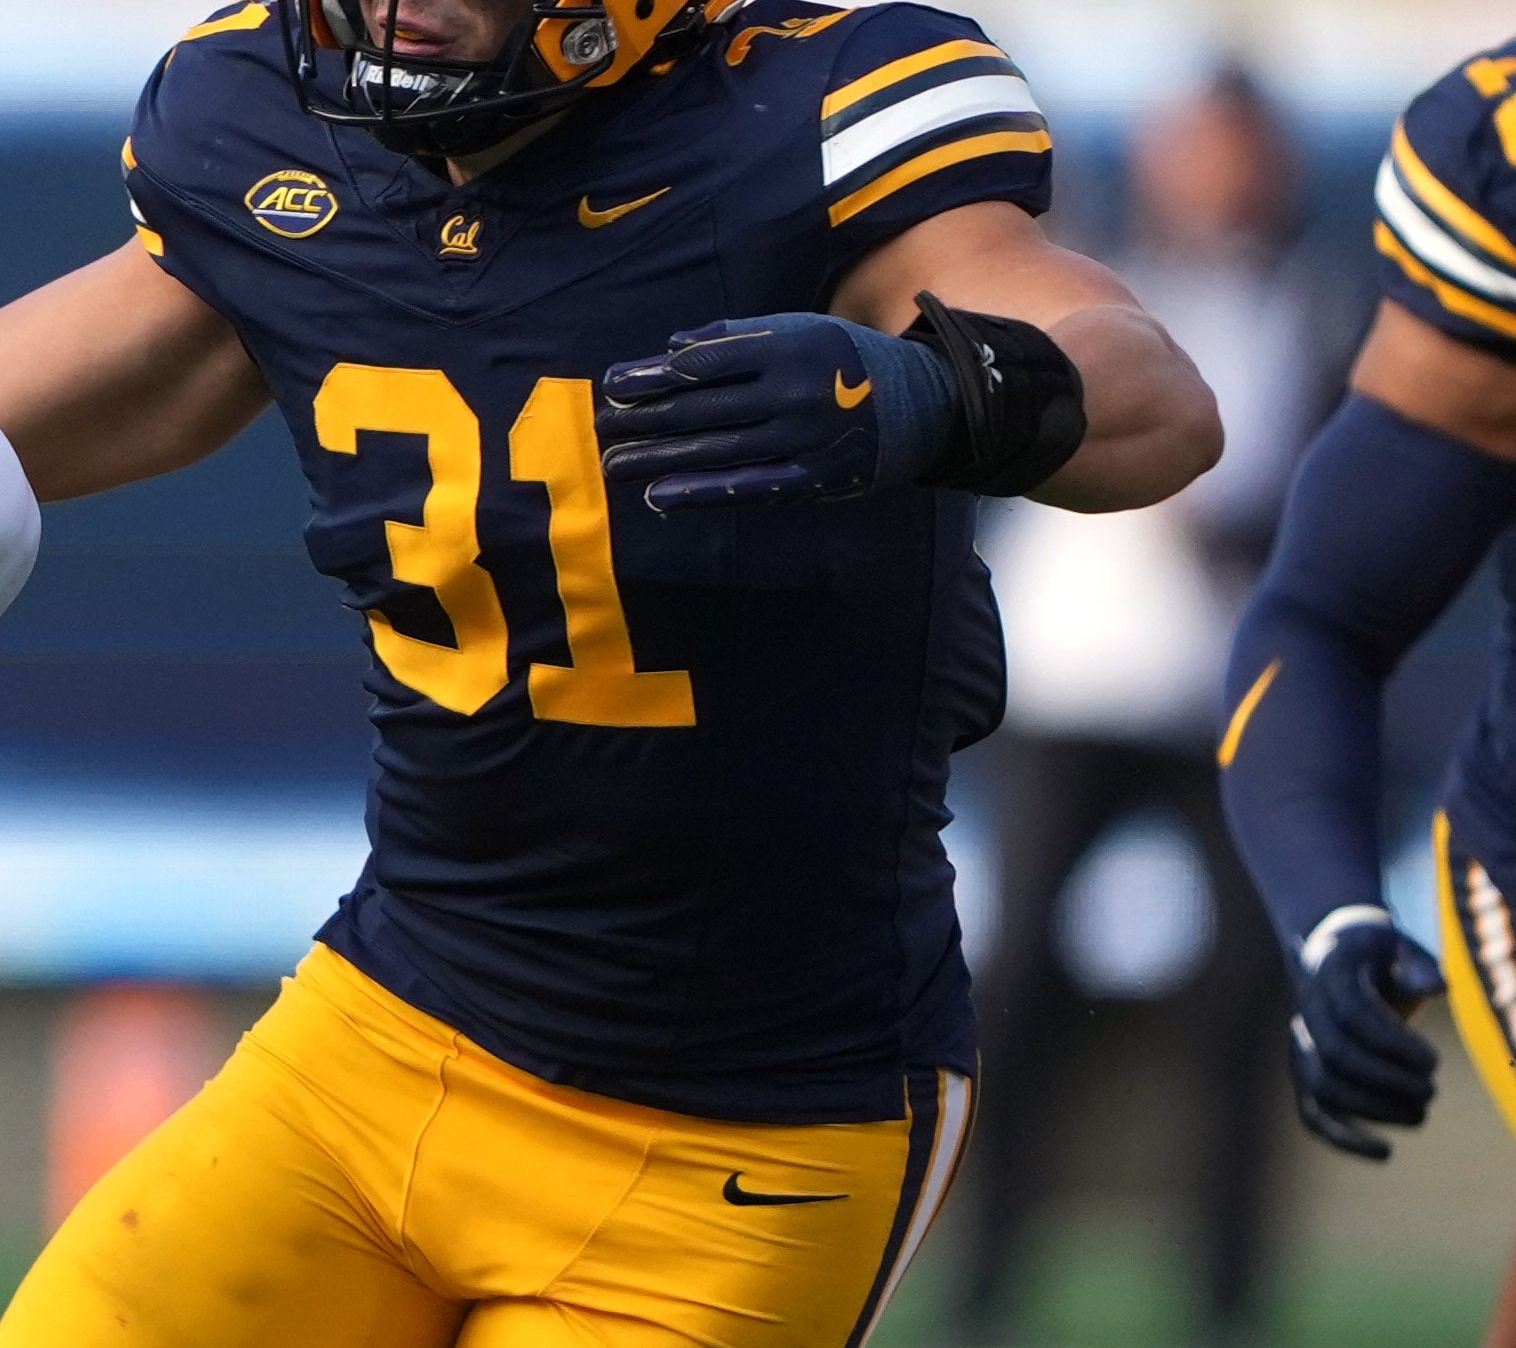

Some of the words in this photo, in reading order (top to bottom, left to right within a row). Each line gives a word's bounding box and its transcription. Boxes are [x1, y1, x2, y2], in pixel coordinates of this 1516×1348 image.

[257, 186, 327, 212] ACC
[438, 215, 481, 255] Cal
[313, 363, 697, 727] 31
